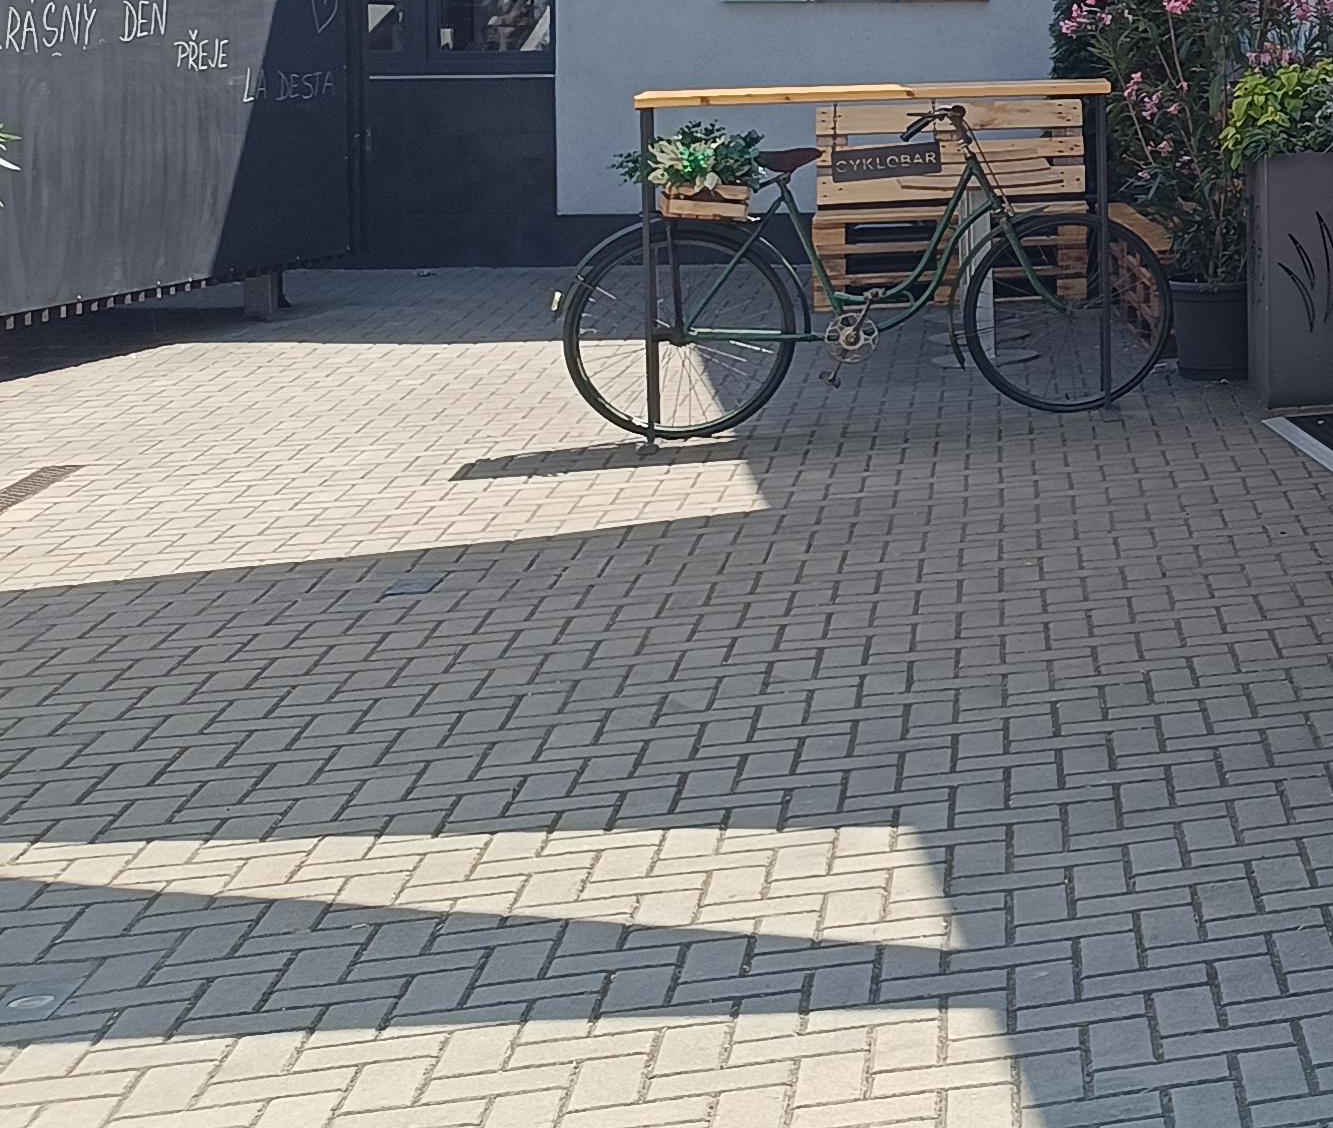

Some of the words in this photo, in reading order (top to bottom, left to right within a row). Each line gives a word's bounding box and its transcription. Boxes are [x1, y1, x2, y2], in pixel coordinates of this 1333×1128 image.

[173, 29, 230, 71] PŘEJE
[242, 67, 267, 103] LA
[275, 70, 336, 102] DESTA
[835, 152, 937, 173] CYKLOBAR
